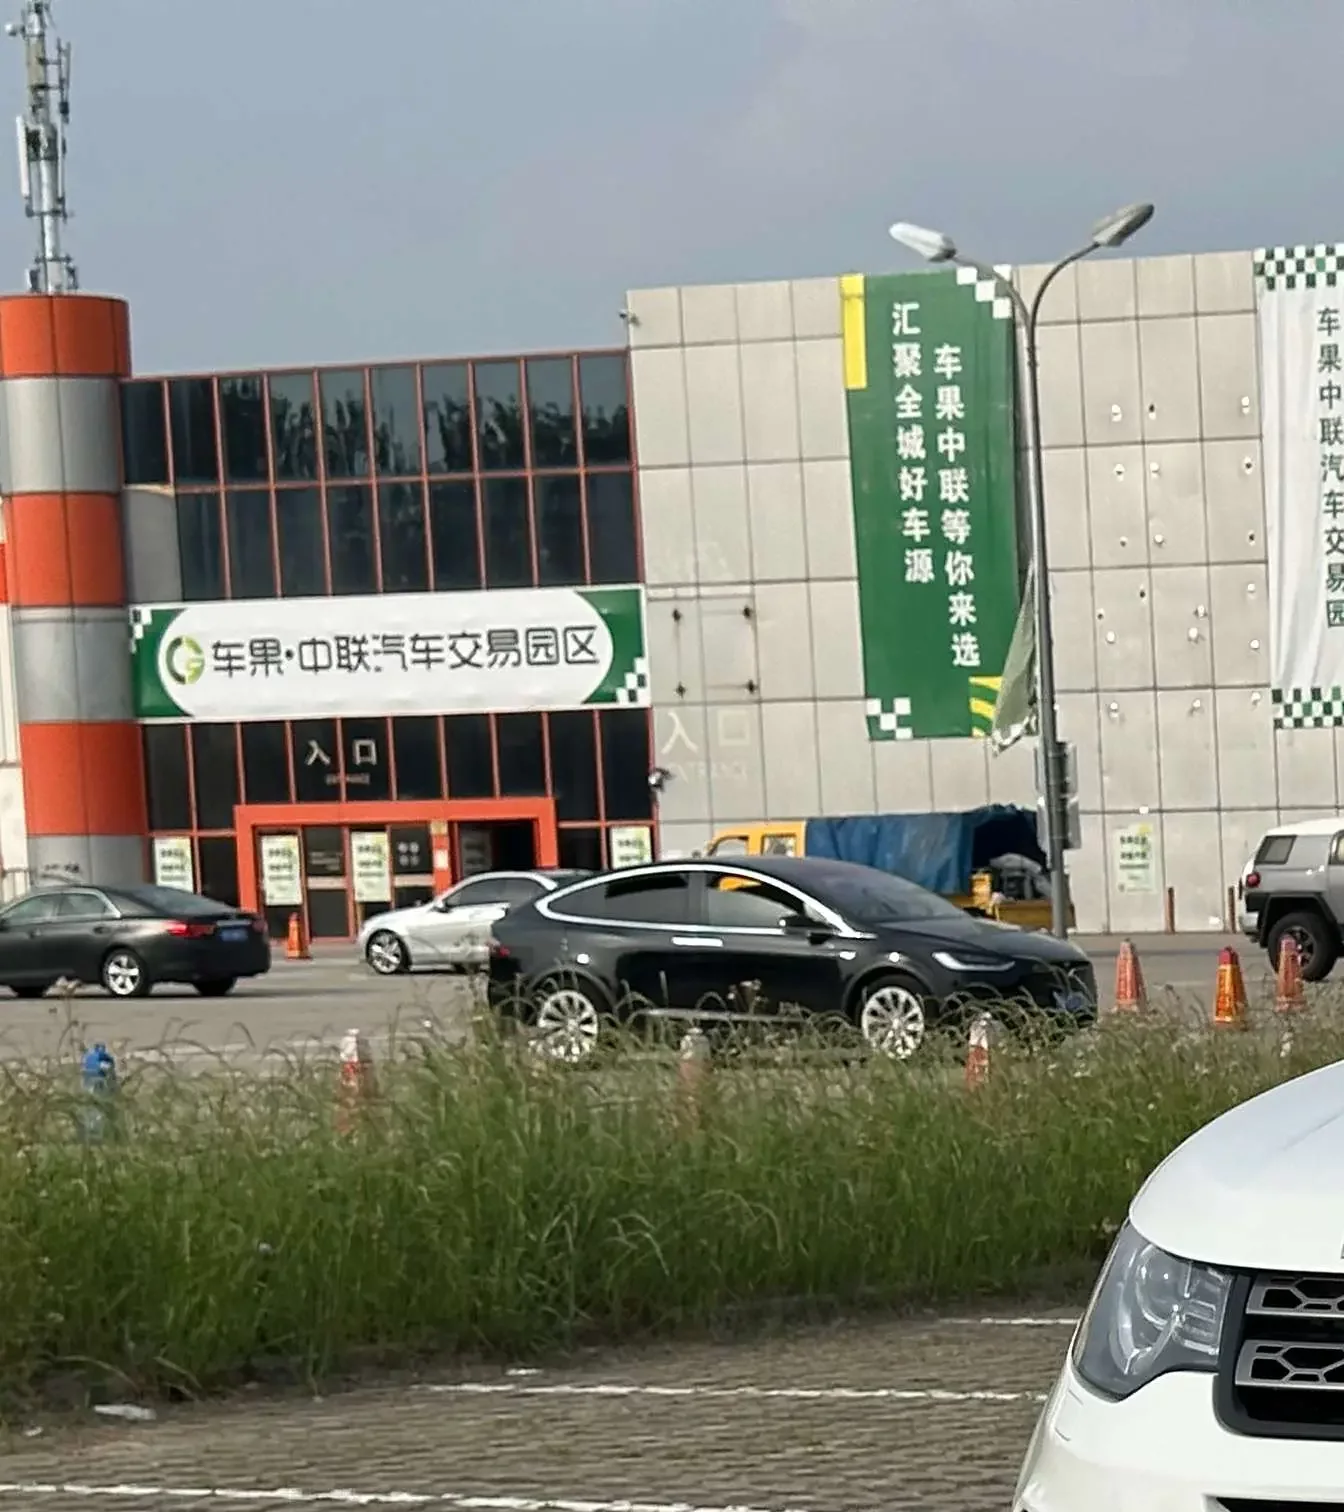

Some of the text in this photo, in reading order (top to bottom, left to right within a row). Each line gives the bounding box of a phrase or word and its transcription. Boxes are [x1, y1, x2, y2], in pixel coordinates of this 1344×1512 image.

[892, 302, 935, 583] 汇聚全城好车源
[933, 343, 981, 667] 车果中联等你来选
[212, 625, 599, 678] 车果·中联汽车交易园区
[305, 739, 377, 766] 入口
